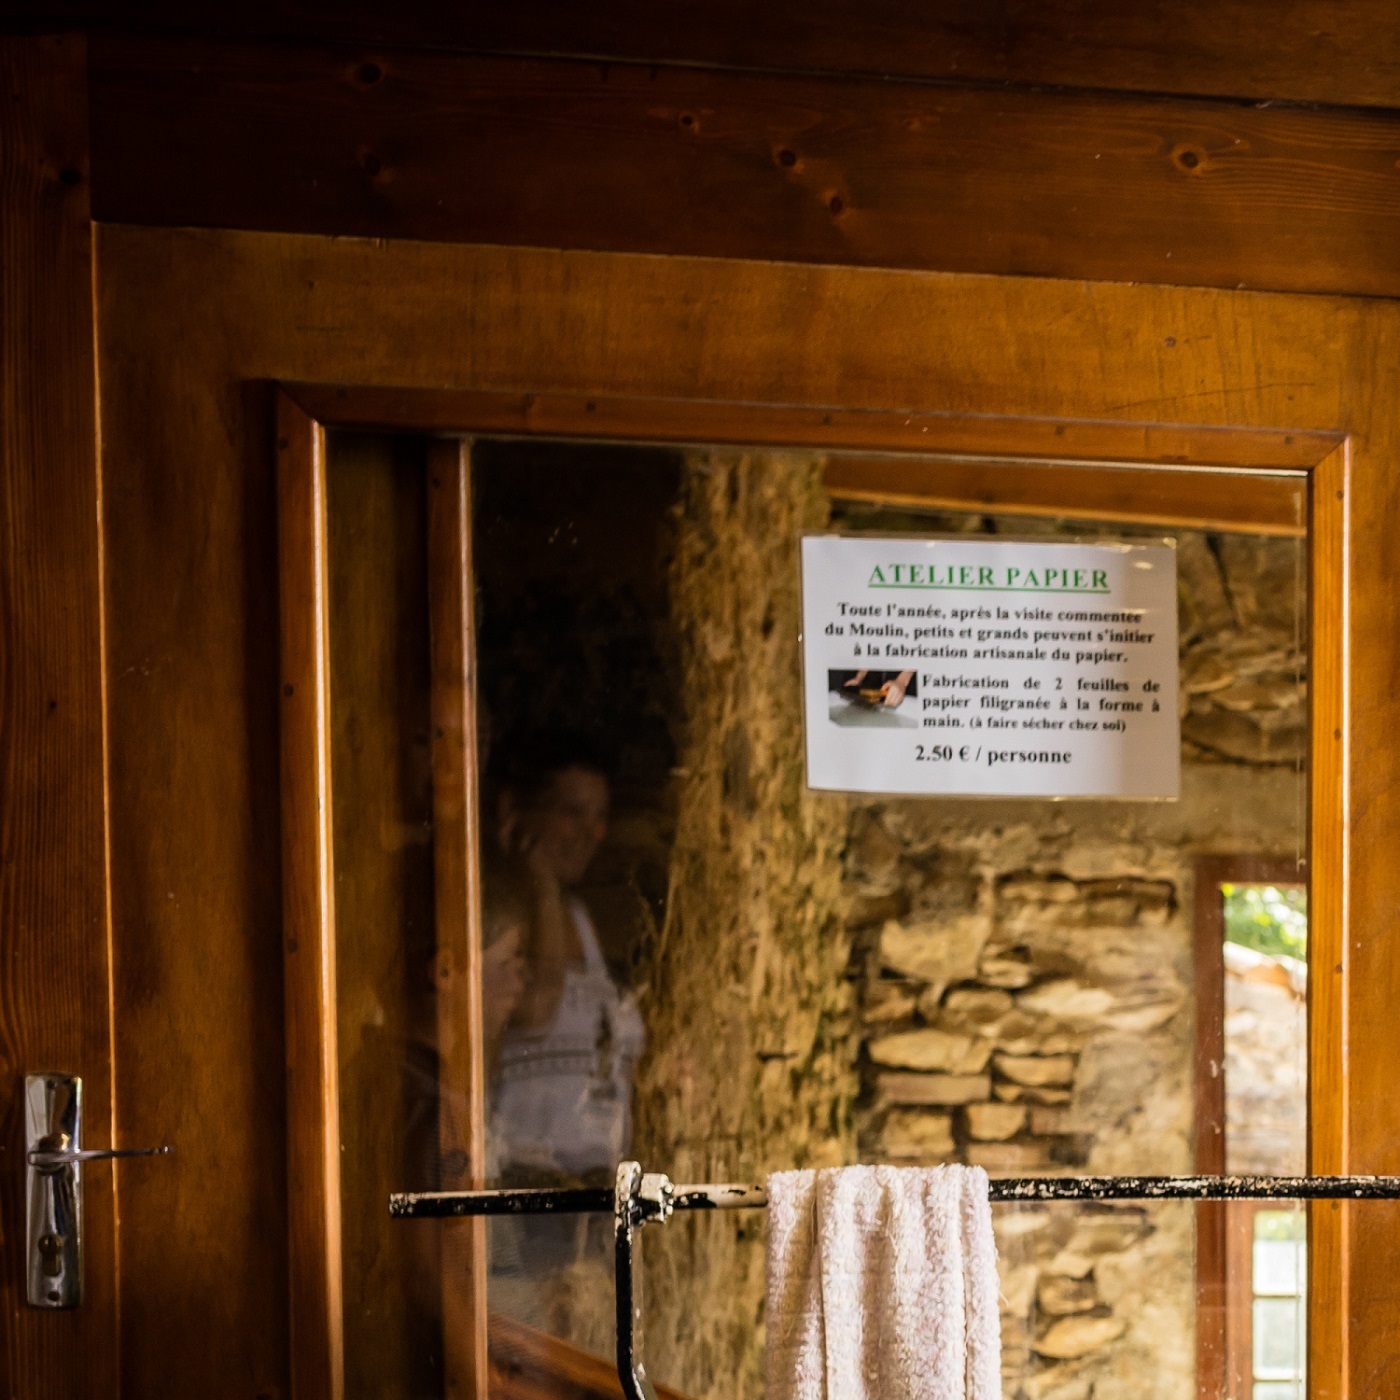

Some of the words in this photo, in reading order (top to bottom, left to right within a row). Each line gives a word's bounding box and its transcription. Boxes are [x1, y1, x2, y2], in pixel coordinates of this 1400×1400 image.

[868, 563, 995, 588] ATELIER
[1006, 566, 1109, 591] PAPIER
[837, 602, 882, 617] Toute
[887, 603, 946, 619] l'année,
[951, 605, 991, 622] après
[996, 607, 1009, 620] la
[1014, 607, 1053, 621] visite
[825, 622, 844, 636] du
[850, 623, 909, 639] Moulin,
[914, 624, 954, 641] petits
[959, 627, 972, 638] et
[977, 627, 1028, 642] grands
[1034, 630, 1092, 644] peuvent
[1097, 628, 1155, 644] s'initier
[853, 642, 862, 656] à
[867, 644, 880, 656] la
[885, 644, 968, 659] fabrication
[973, 646, 1047, 660] artisanale
[1051, 647, 1070, 661] du
[1076, 648, 1128, 664] papier.
[923, 674, 1009, 689] Fabrication
[1024, 676, 1040, 690] de
[1055, 677, 1063, 690] 2
[1077, 678, 1129, 692] feuilles
[1143, 679, 1160, 693] de
[923, 695, 971, 711] papier
[980, 695, 1051, 713] filigranée
[1060, 697, 1068, 711] à
[1077, 697, 1090, 711] la
[1100, 698, 1144, 712] forme
[1151, 699, 1160, 713] à
[923, 714, 965, 728] main.
[969, 717, 982, 730] (à
[987, 716, 1018, 729] faire
[1022, 716, 1064, 730] sécher
[1069, 718, 1098, 731] chez
[1102, 718, 1126, 733] soi)
[915, 745, 953, 762] 2.50
[959, 745, 970, 762] €
[975, 746, 982, 762] /
[988, 750, 1072, 766] personne
